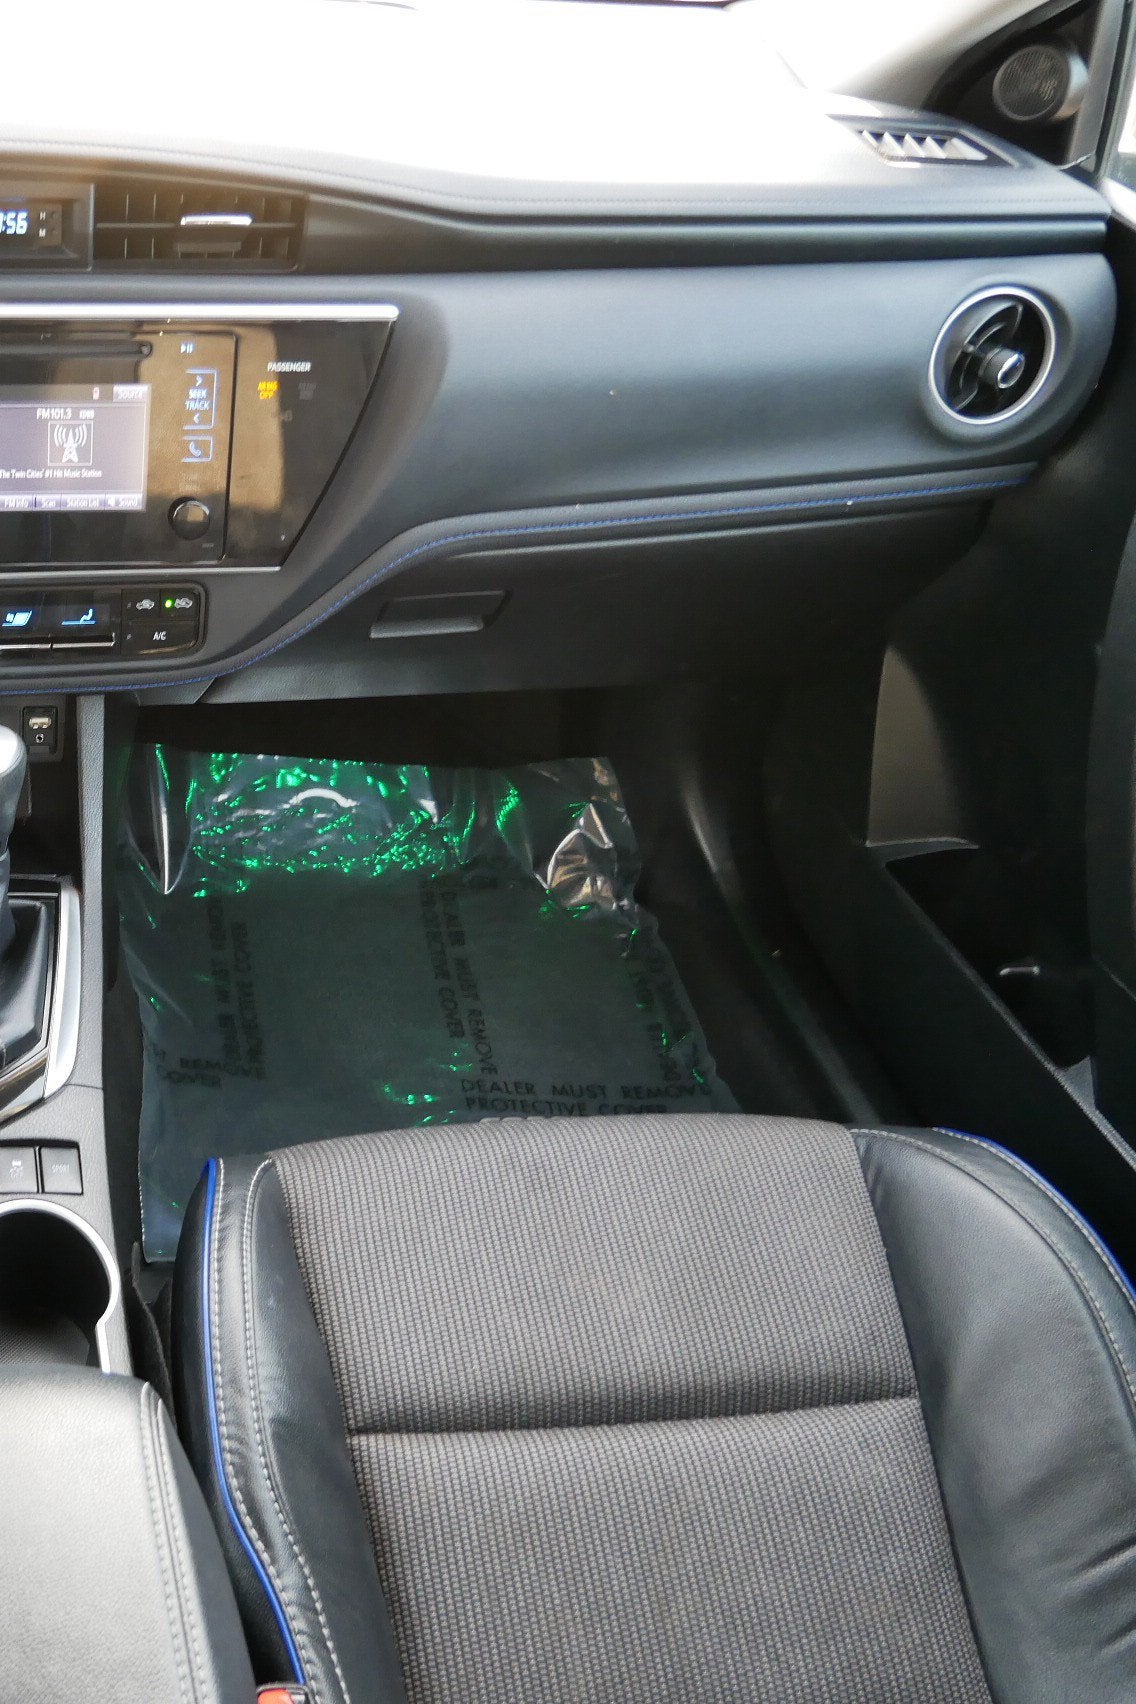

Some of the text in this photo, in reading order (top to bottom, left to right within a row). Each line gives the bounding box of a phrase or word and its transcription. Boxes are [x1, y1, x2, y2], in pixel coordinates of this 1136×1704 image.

[39, 211, 47, 221] H
[38, 228, 46, 237] M
[266, 361, 312, 373] PASSENGER
[184, 400, 210, 411] TRACK
[11, 469, 26, 479] Twin
[81, 468, 102, 478] Station
[152, 631, 167, 641] A/C
[460, 1078, 536, 1096] DEALER
[551, 1082, 608, 1100] MUST
[465, 1096, 588, 1117] PROTECTIVE
